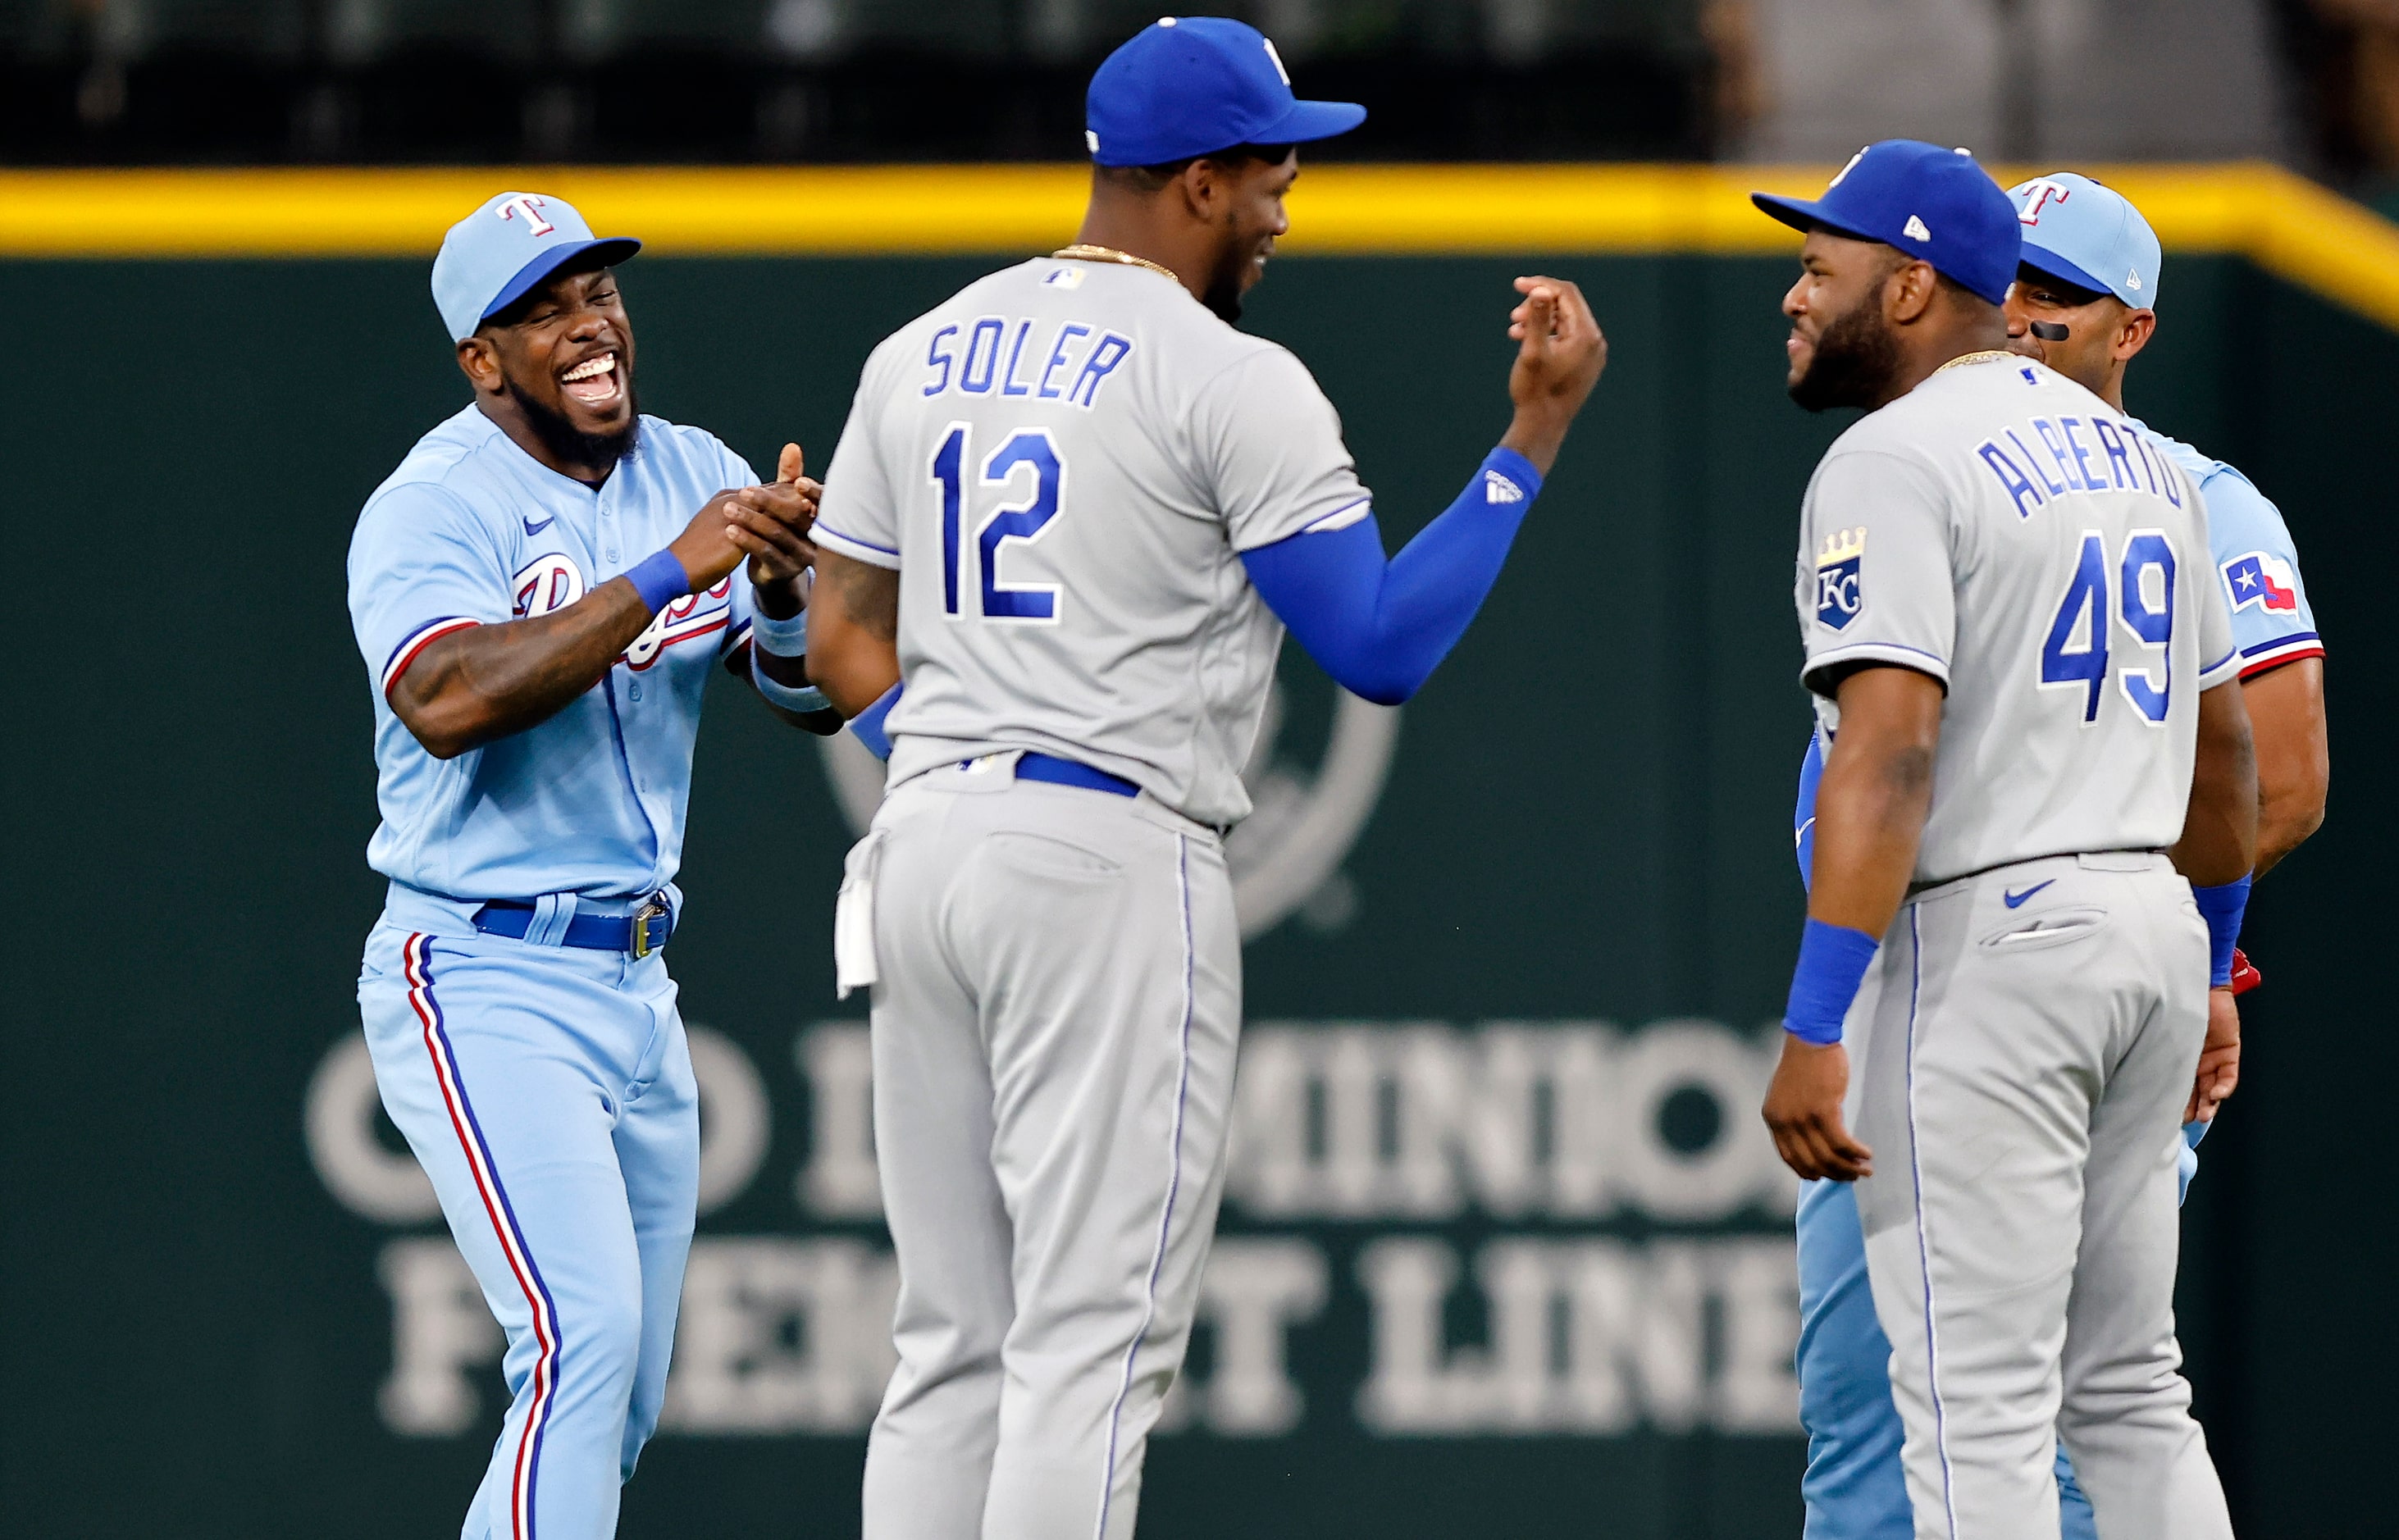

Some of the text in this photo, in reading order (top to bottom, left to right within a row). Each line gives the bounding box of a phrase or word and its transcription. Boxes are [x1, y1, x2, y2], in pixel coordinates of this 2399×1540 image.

[495, 194, 554, 237] T
[2018, 178, 2069, 226] T
[921, 315, 1134, 411] SOLER
[1972, 413, 2186, 522] ALBERTO
[928, 421, 1067, 629] 12
[1817, 567, 1861, 614] KC
[2036, 528, 2178, 727] 49
